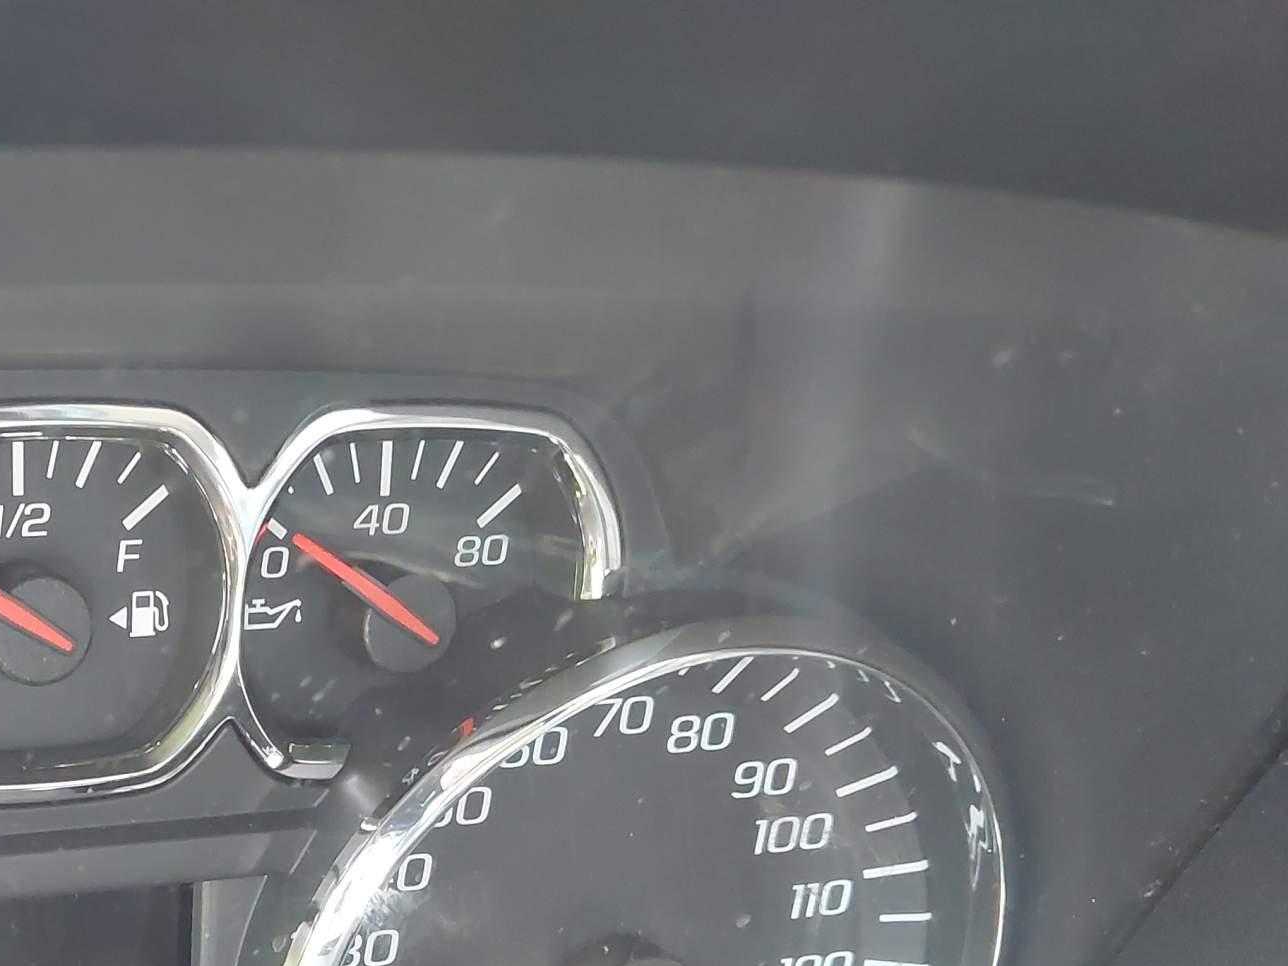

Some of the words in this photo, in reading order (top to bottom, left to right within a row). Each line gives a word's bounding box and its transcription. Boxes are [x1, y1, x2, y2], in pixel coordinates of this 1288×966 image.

[353, 503, 410, 536] 40
[116, 539, 143, 572] F
[261, 547, 289, 578] 0
[454, 534, 509, 567] 80
[593, 696, 654, 737] 70
[667, 713, 734, 754] 80
[731, 758, 798, 798] 90
[434, 786, 492, 828] 0
[754, 813, 833, 855] 100
[790, 879, 854, 920] 110
